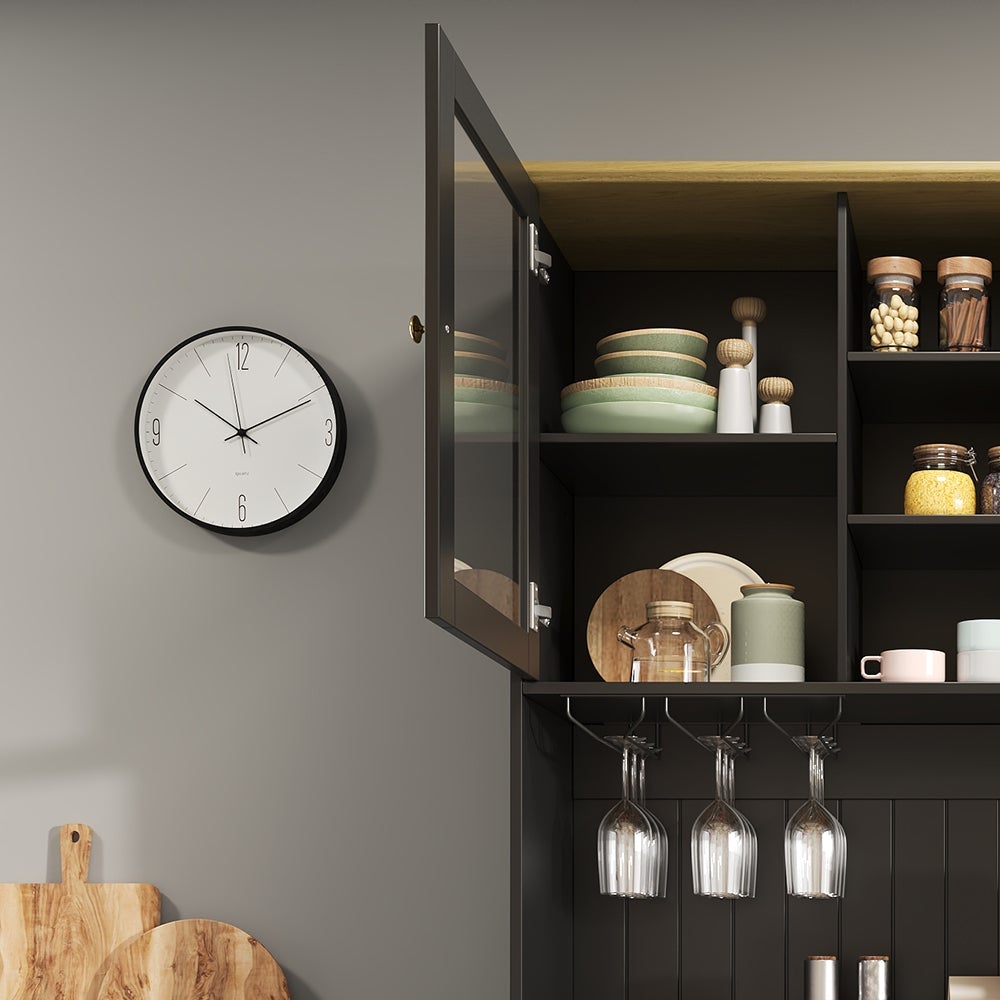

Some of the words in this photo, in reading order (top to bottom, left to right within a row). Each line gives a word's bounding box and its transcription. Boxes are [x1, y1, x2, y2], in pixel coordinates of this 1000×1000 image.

[235, 342, 250, 371] 12
[152, 418, 161, 446] 9
[325, 418, 333, 446] 3
[238, 494, 246, 521] 6
